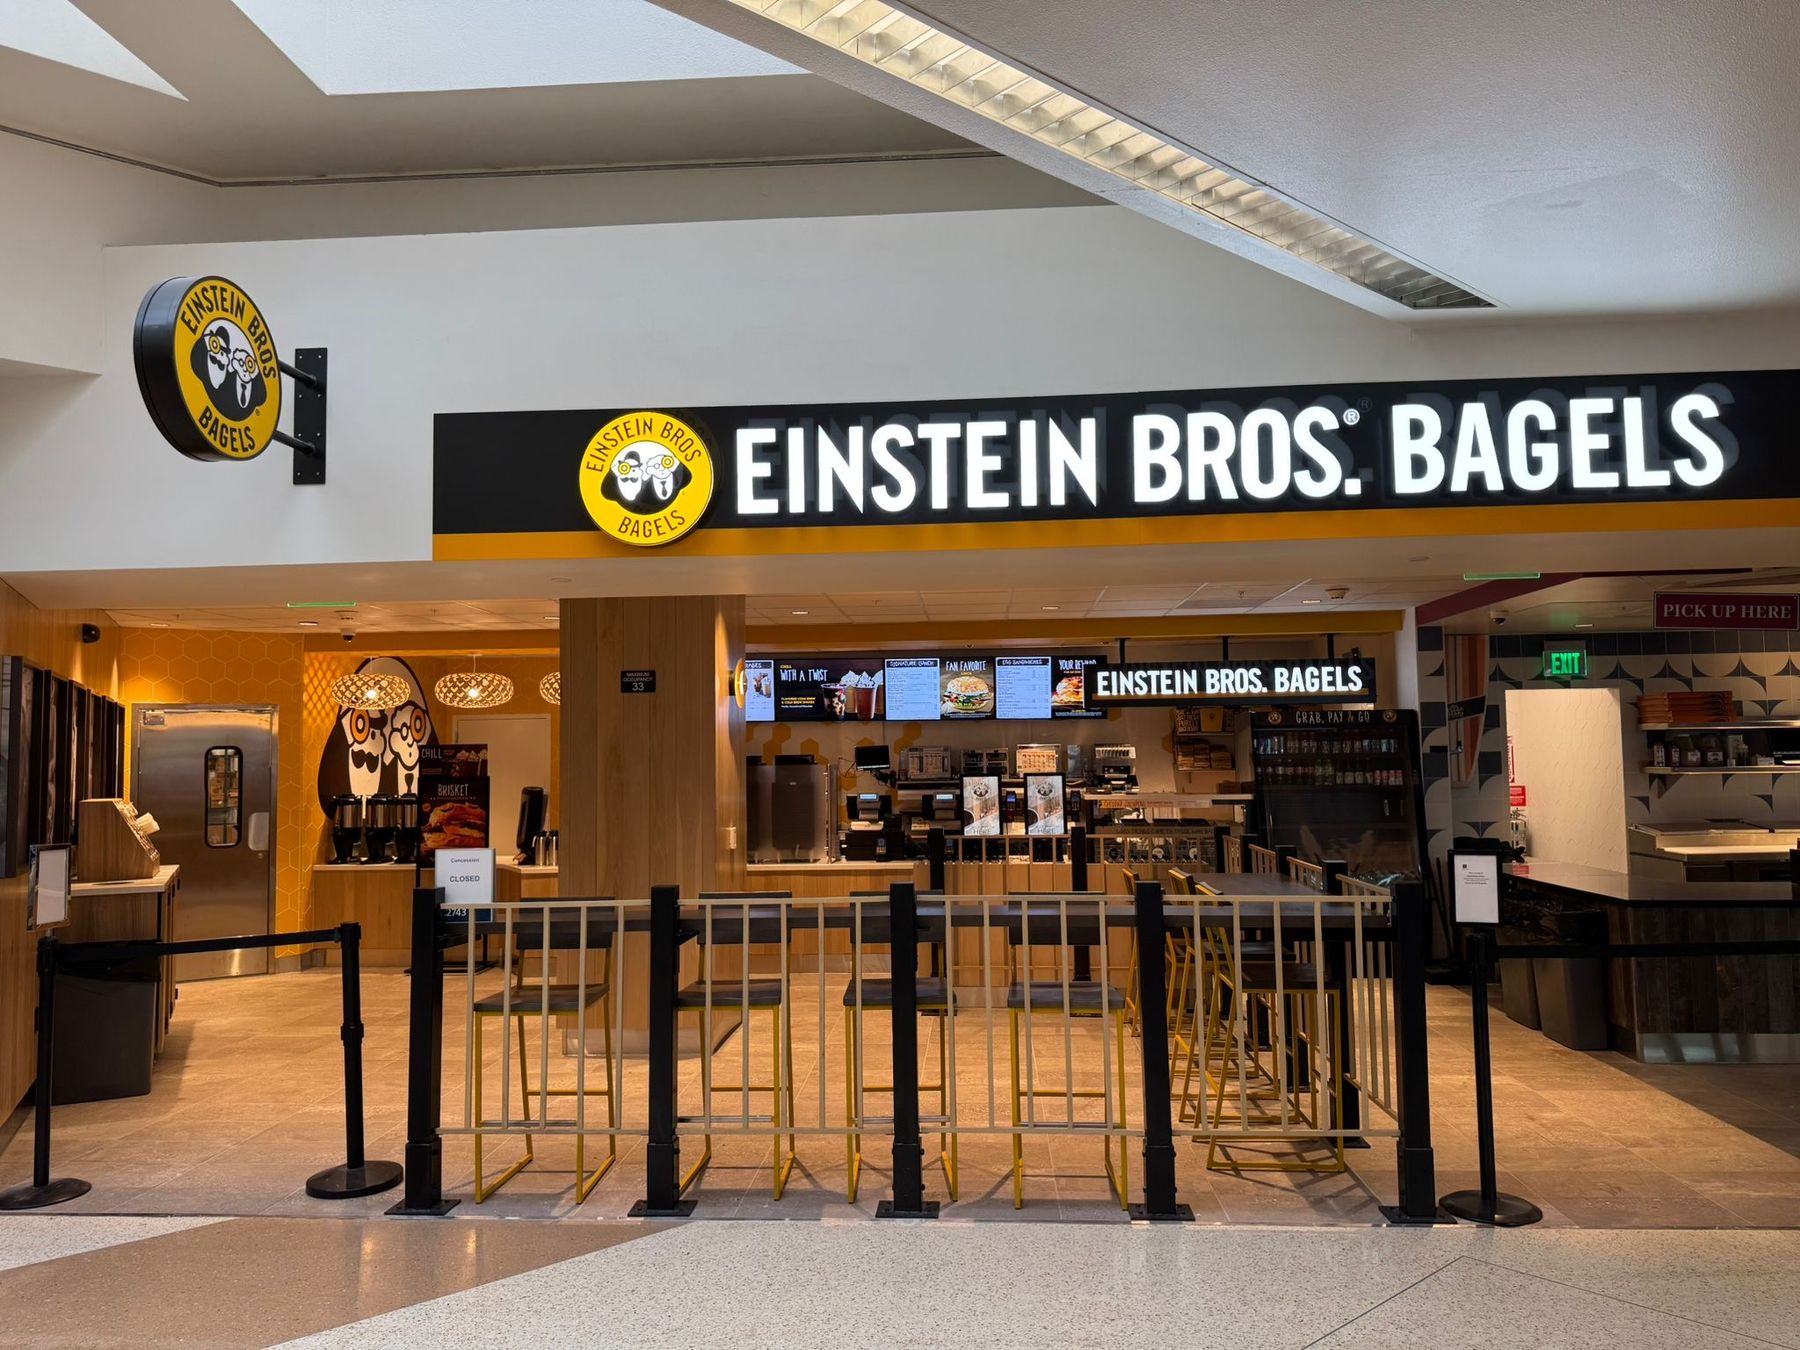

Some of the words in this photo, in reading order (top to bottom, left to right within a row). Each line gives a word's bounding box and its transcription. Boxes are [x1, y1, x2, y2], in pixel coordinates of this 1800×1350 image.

[180, 284, 245, 336] EINSTEIN
[247, 315, 277, 380] BROS
[198, 405, 256, 453] BAGELS
[586, 418, 653, 473] EINSTEIN
[660, 421, 702, 463] BROS
[736, 417, 1097, 515] EINSTEIN
[1392, 393, 1725, 495] BAGELS
[617, 509, 686, 539] BAGELS
[1662, 603, 1706, 618] PICK
[1711, 604, 1736, 618] UP
[1740, 605, 1792, 619] HERE
[945, 660, 959, 672] FAN
[960, 660, 987, 672] FAVORITE
[1058, 659, 1074, 671] YOUR
[1551, 652, 1581, 675] EXIT
[780, 668, 797, 682] WITH
[799, 669, 806, 682] A
[808, 669, 828, 682] TWIST
[1097, 669, 1199, 696] EINSTEIN
[1205, 668, 1268, 694] BROS.
[1274, 666, 1363, 693] BAGELS
[632, 682, 645, 691] 33
[1327, 711, 1344, 724] PAY
[1358, 711, 1370, 723] GO
[421, 747, 443, 759] CHILL
[437, 783, 469, 797] BRISKET
[449, 875, 480, 883] CLOSED
